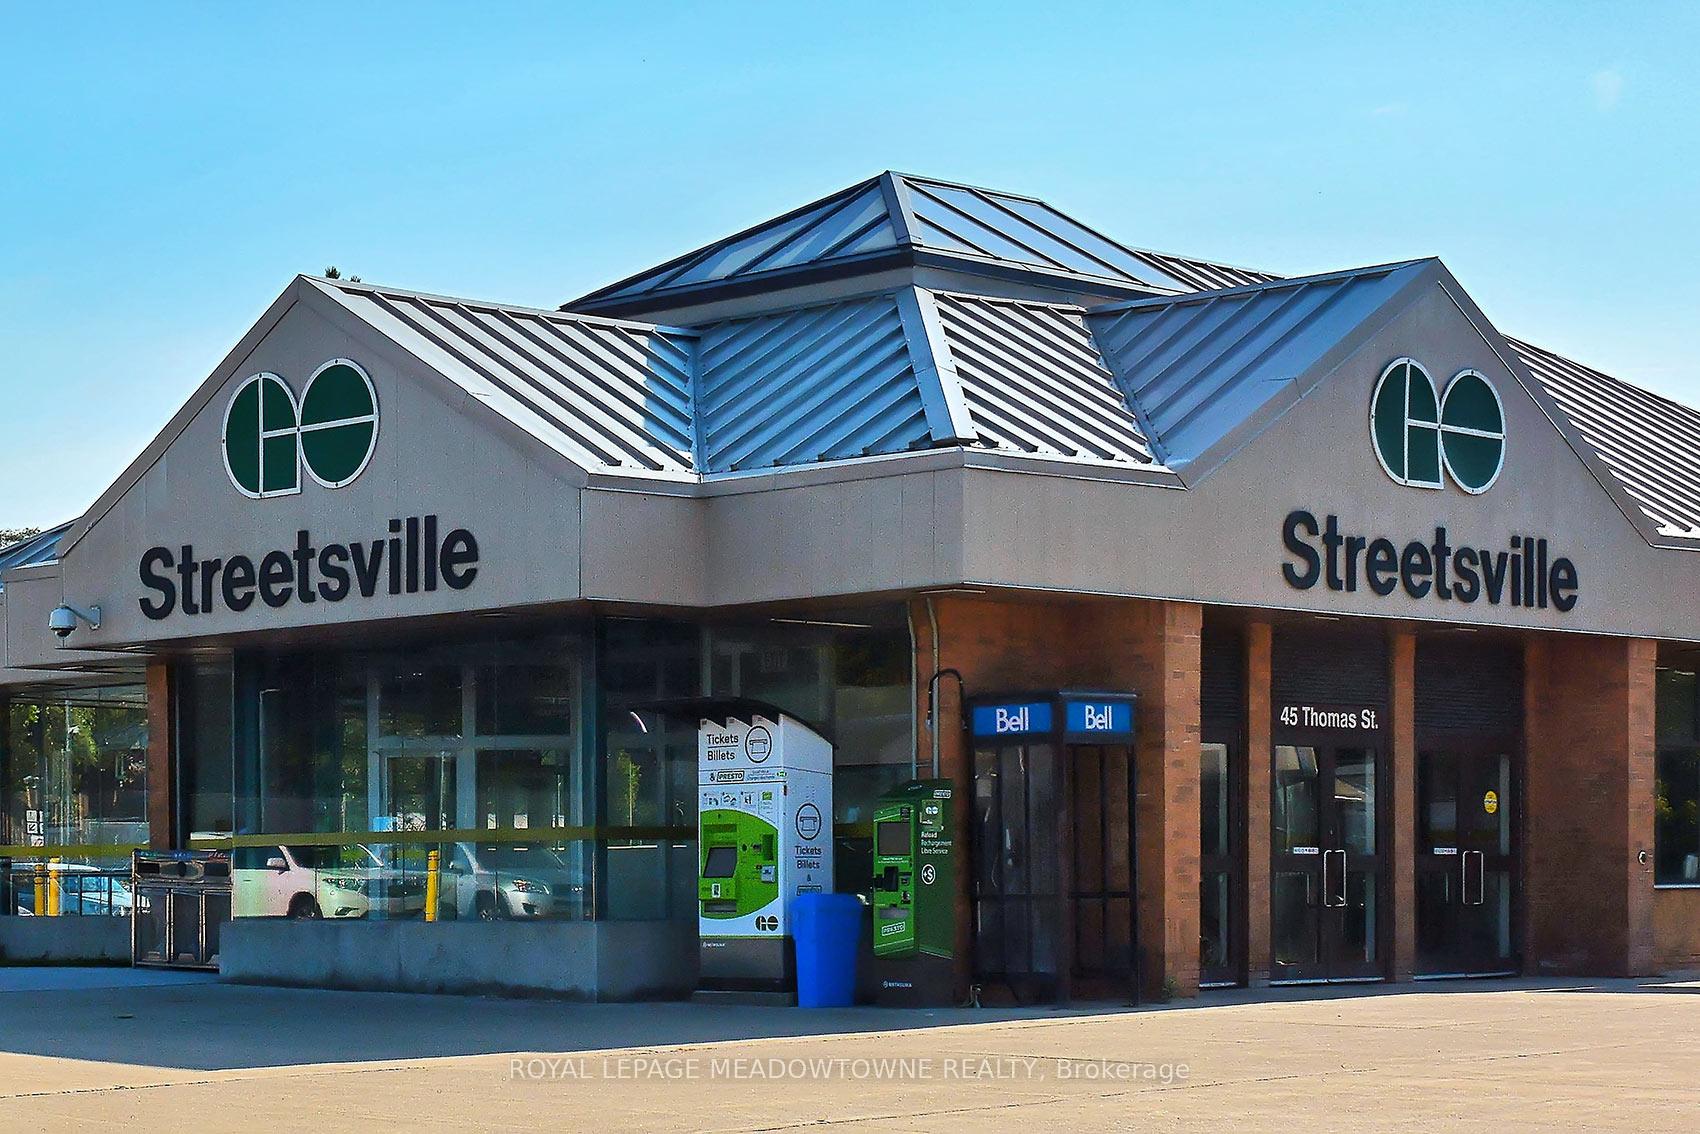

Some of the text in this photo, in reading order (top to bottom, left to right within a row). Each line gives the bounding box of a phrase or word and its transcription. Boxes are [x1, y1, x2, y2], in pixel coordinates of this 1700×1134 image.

[139, 514, 479, 620] Streetsville
[1282, 510, 1578, 612] Streetsville
[996, 706, 1029, 733] Bell
[1085, 705, 1113, 730] Bell
[1280, 706, 1379, 729] 45 Thomas St.
[706, 733, 739, 745] Tickets
[707, 750, 735, 760] Billets
[719, 772, 743, 780] PRESTO
[795, 845, 822, 855] Tickets
[797, 859, 820, 869] Billets
